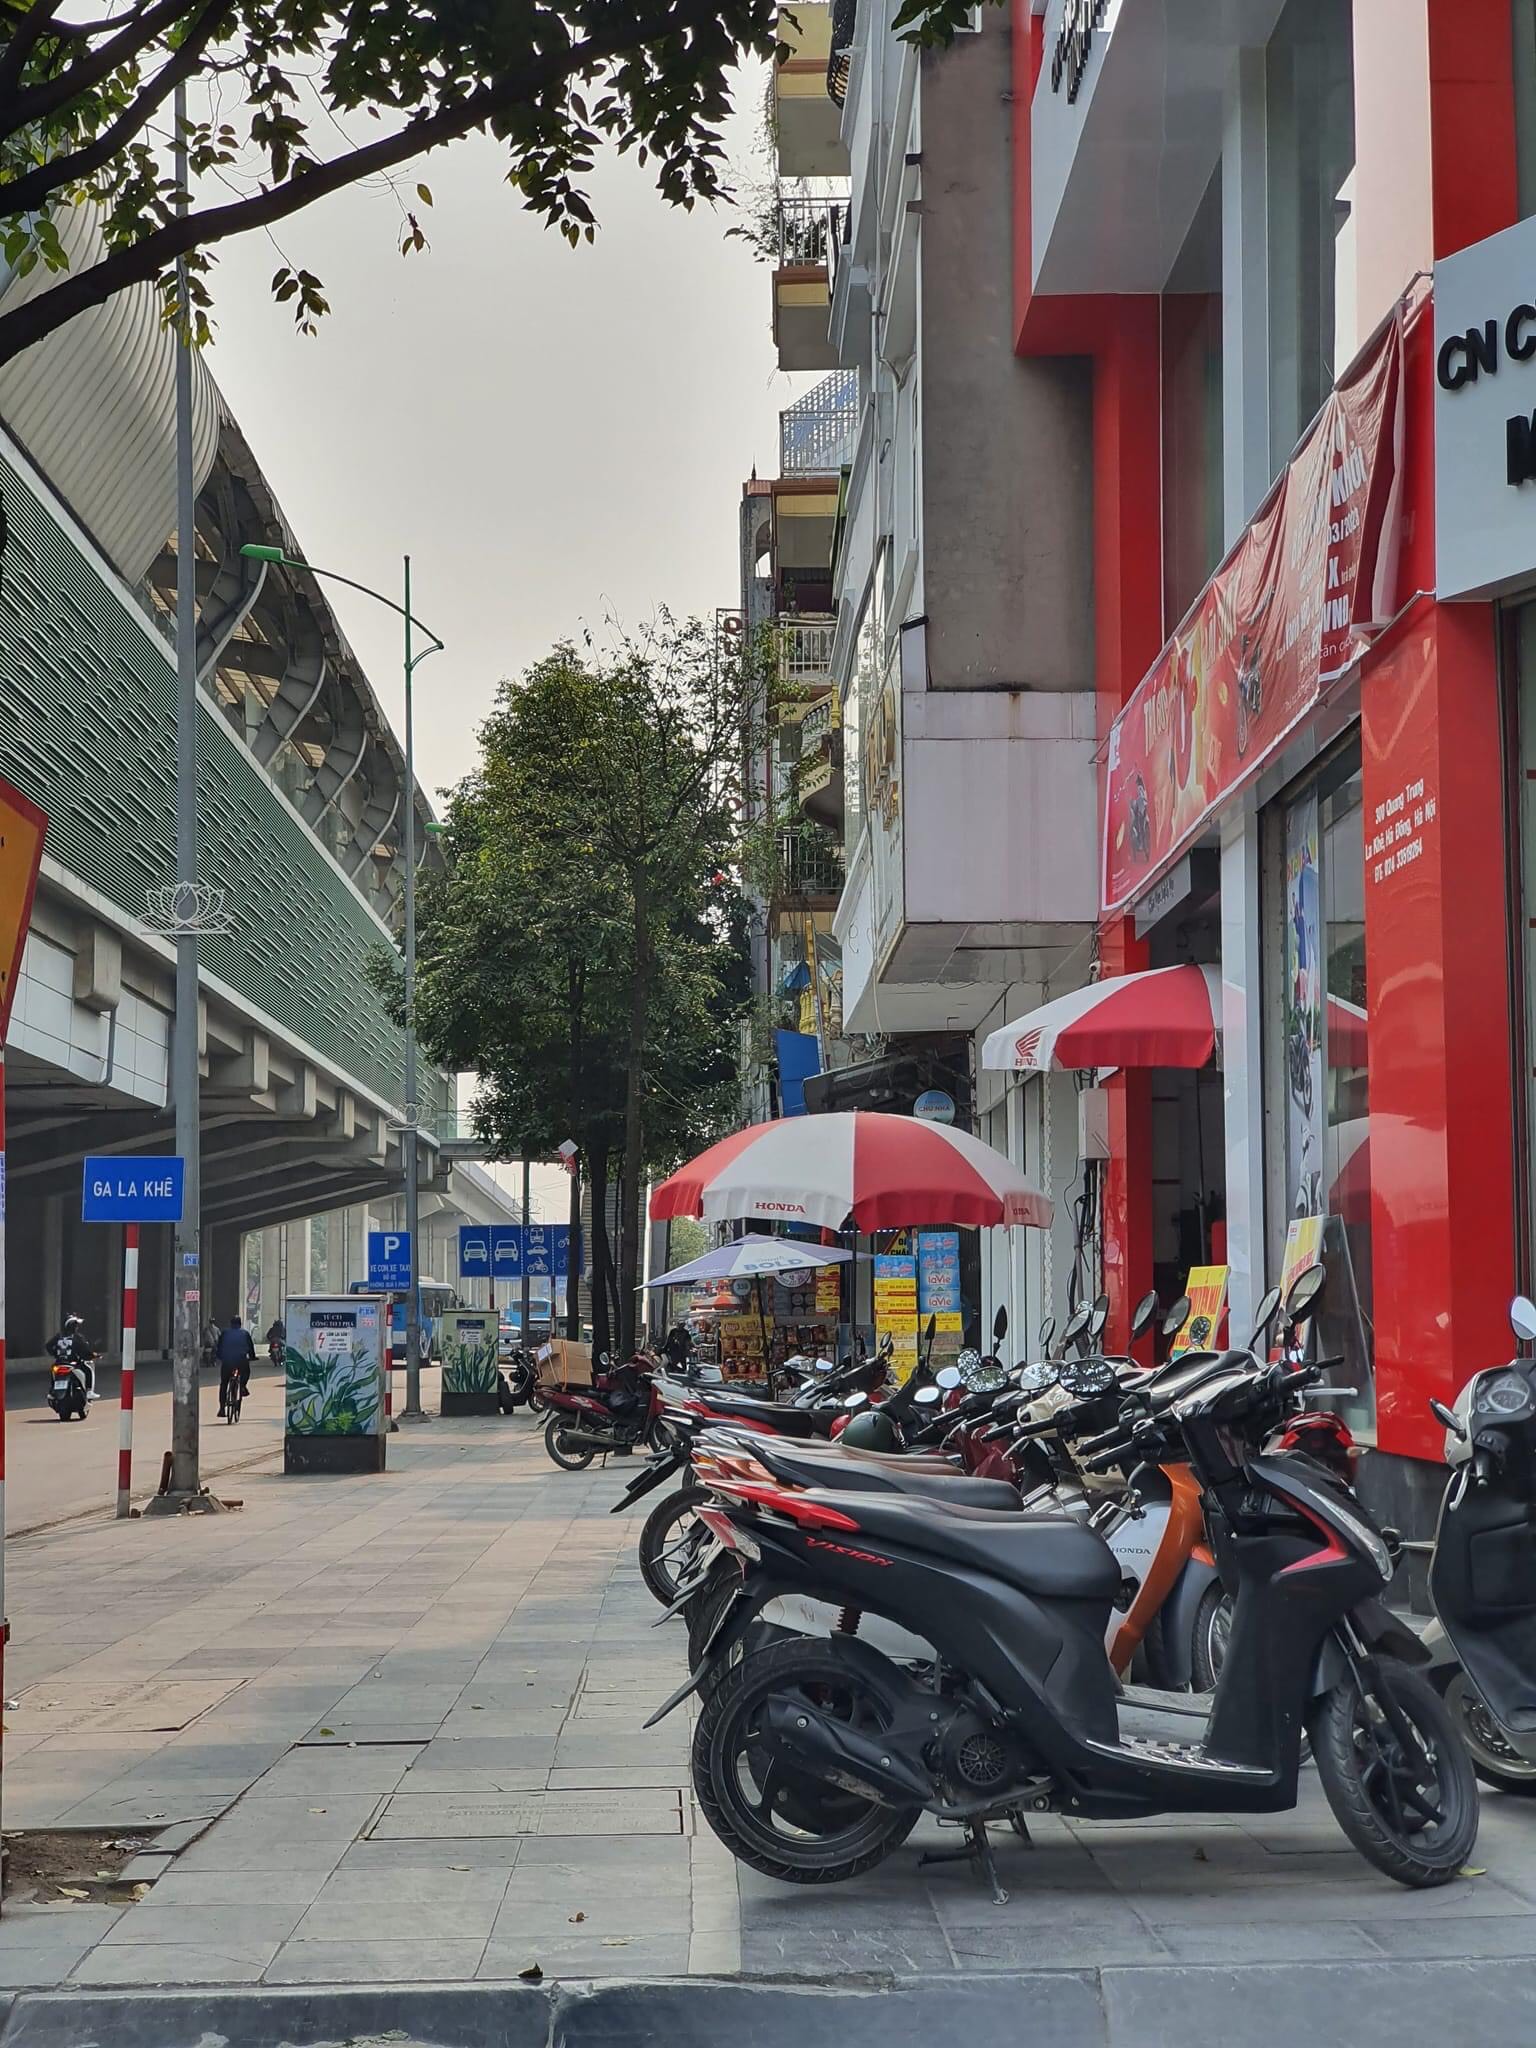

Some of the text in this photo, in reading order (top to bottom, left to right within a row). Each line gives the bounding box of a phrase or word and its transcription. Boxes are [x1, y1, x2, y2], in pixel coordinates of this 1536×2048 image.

[1437, 319, 1497, 391] CN
[1386, 792, 1404, 817] Quang
[1406, 778, 1424, 802] Trung
[93, 1177, 173, 1197] GA LA KHÊ
[755, 1202, 806, 1214] HONDA
[384, 1236, 400, 1260] P
[744, 1258, 803, 1270] BOLD
[928, 1274, 951, 1284] laVie
[929, 1296, 951, 1307] laVie
[806, 1536, 895, 1567] VISION
[1111, 1547, 1151, 1555] HONDA
